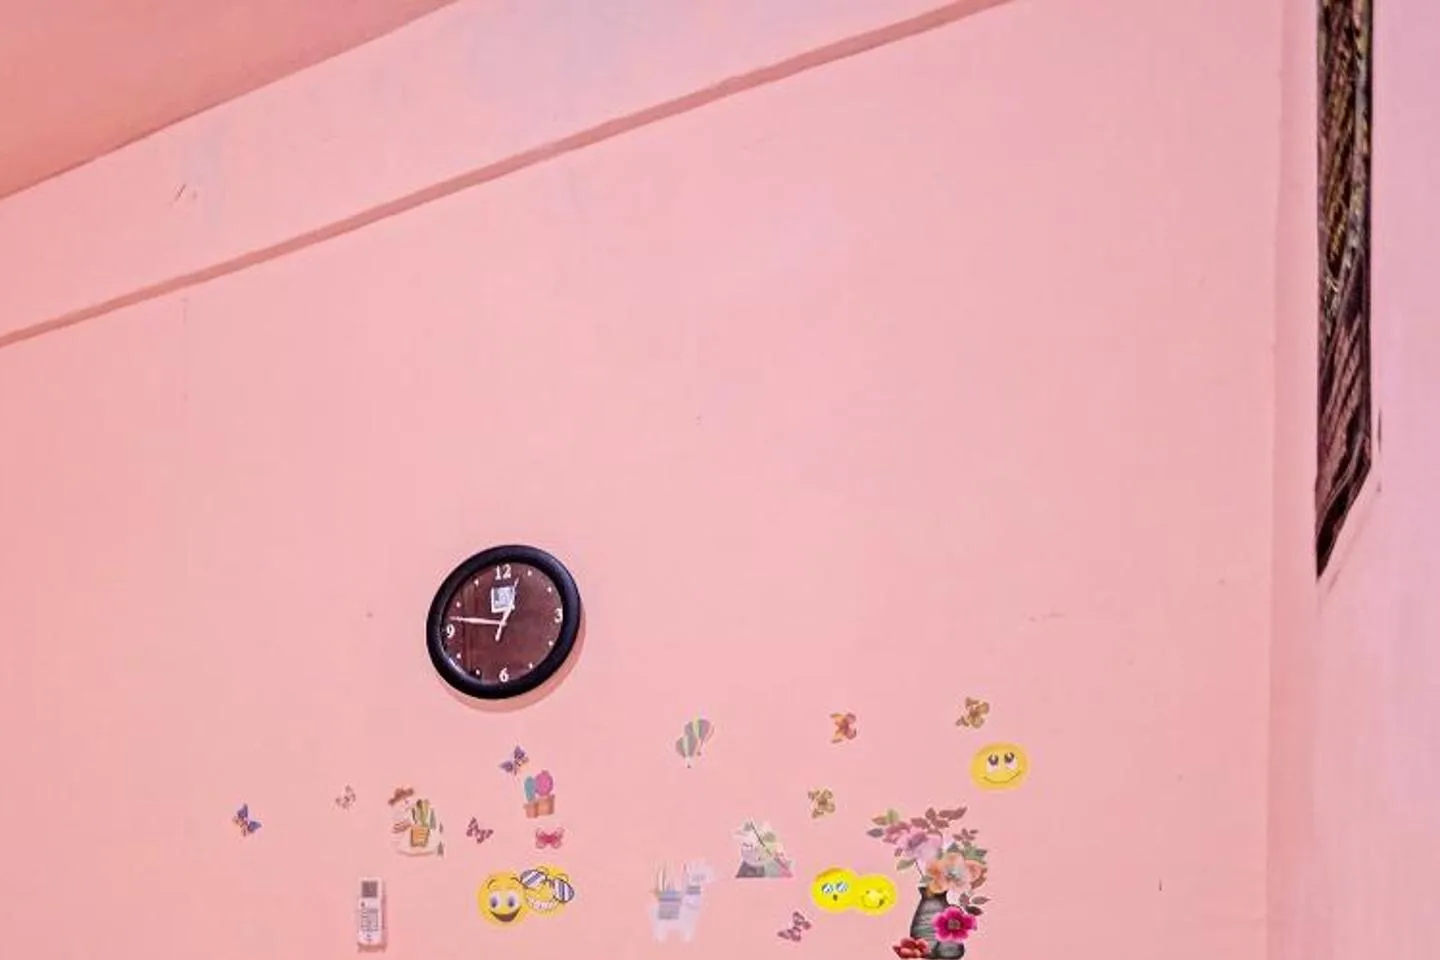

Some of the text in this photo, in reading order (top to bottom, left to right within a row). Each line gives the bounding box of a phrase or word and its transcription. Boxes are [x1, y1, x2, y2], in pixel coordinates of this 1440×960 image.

[494, 563, 512, 581] 12
[554, 607, 564, 623] 3
[445, 623, 456, 639] 9
[498, 667, 510, 683] 6
